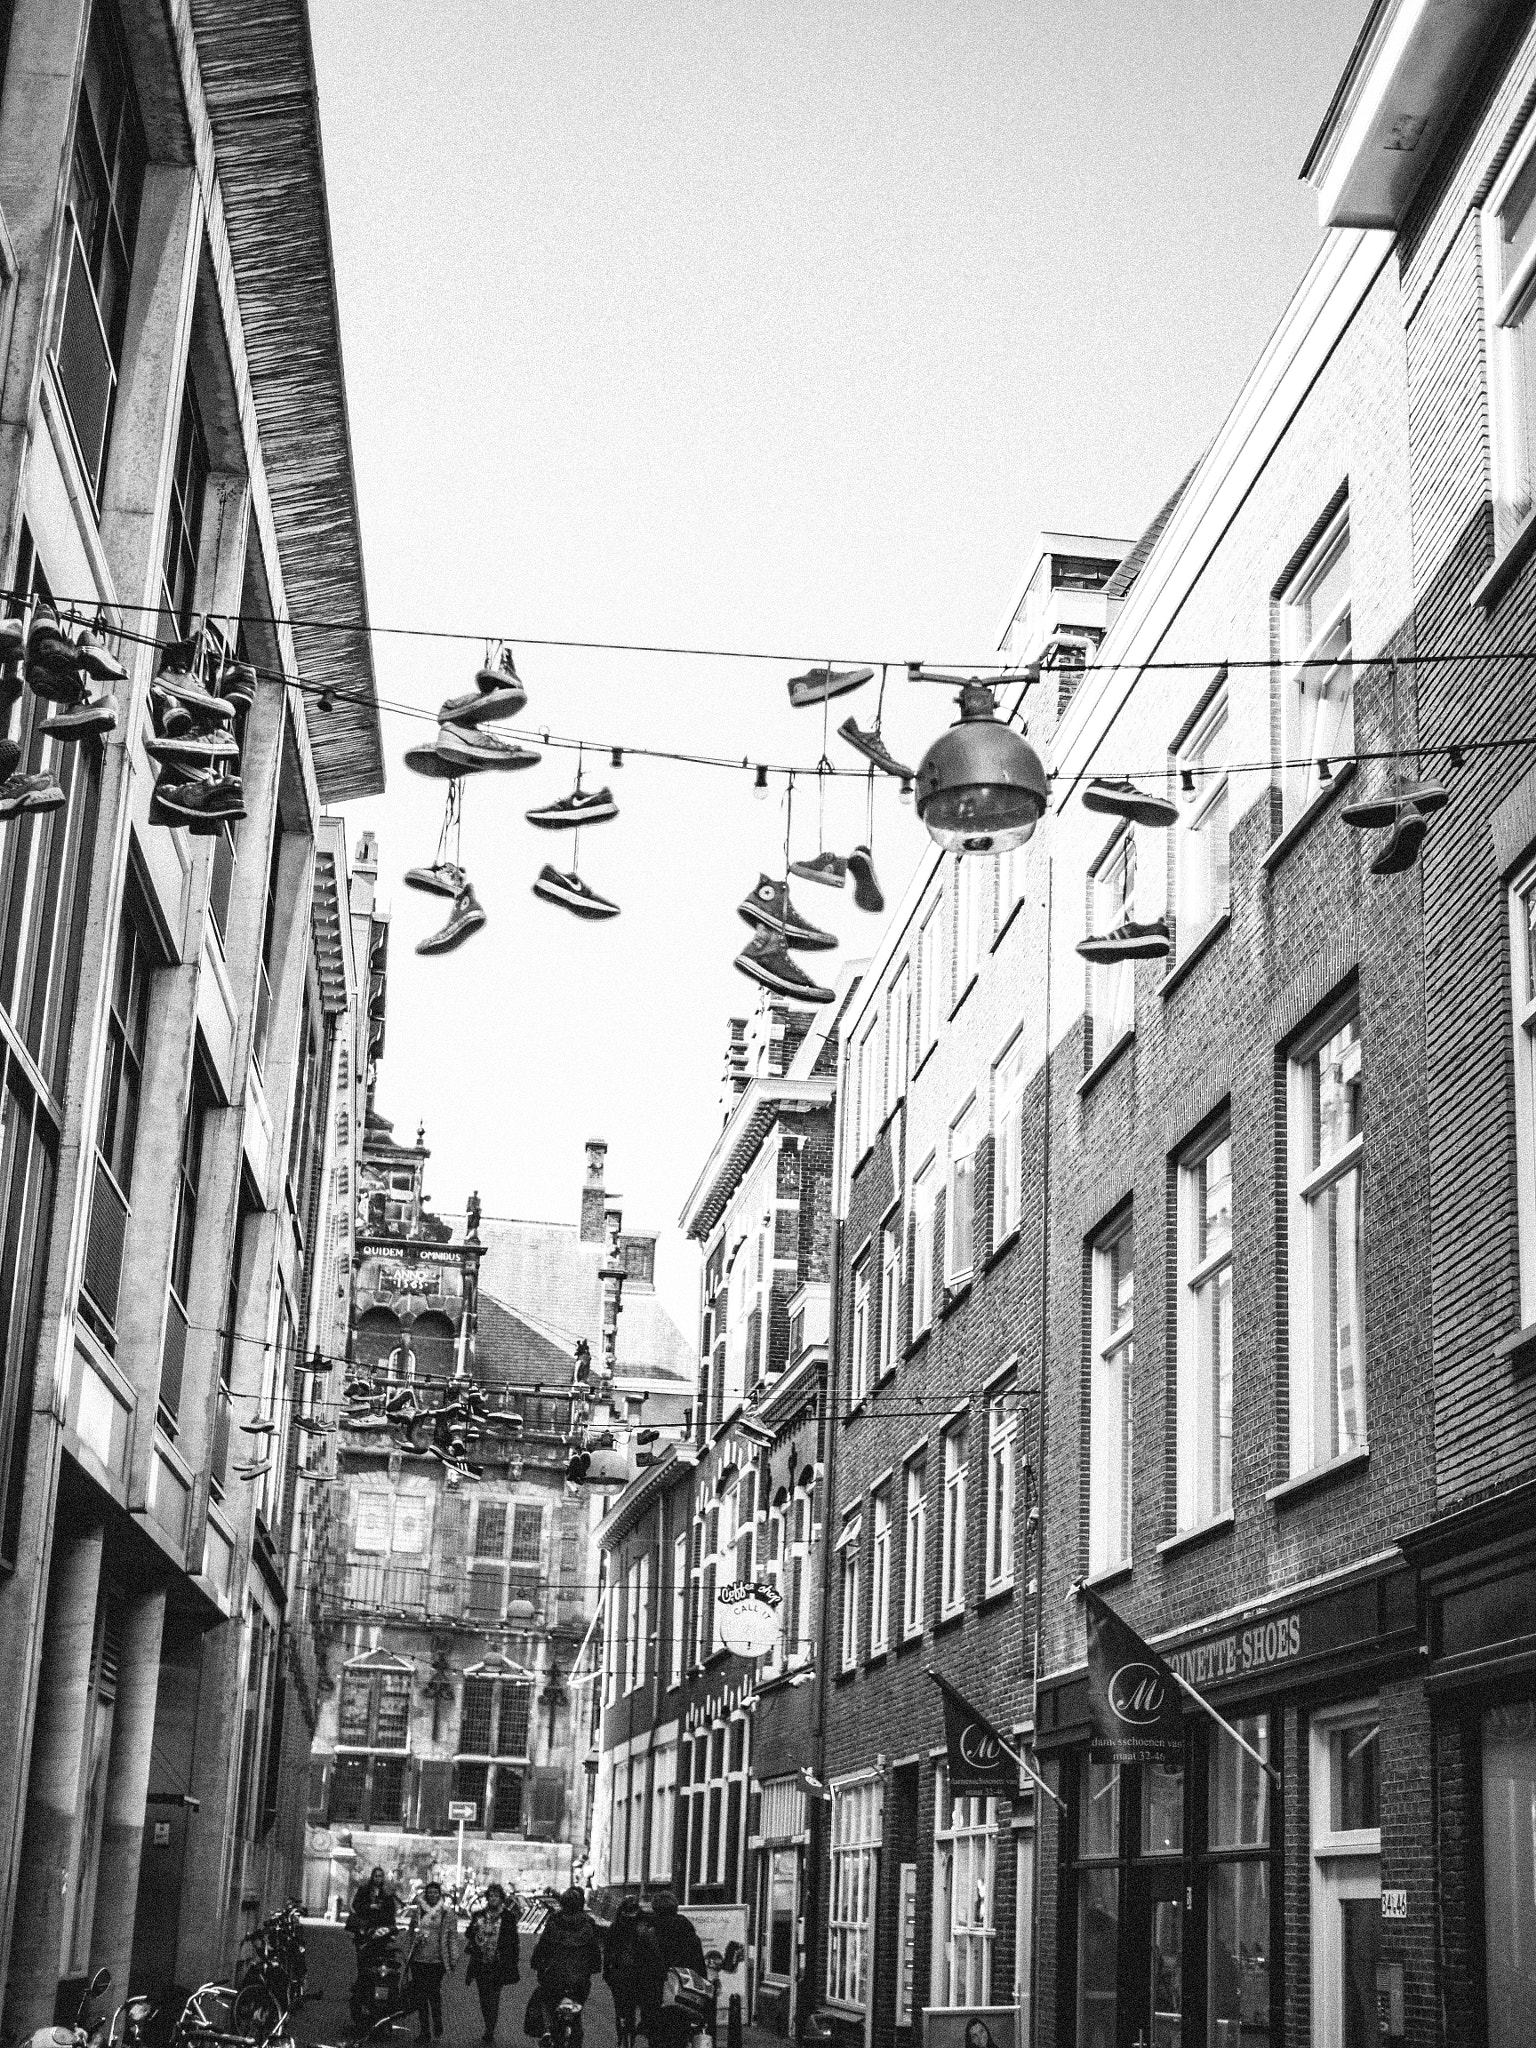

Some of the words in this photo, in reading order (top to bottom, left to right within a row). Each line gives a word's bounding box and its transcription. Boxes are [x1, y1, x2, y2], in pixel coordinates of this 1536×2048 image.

[363, 1246, 404, 1257] QUIDEM
[420, 1251, 461, 1261] OMNIBUS
[393, 1270, 427, 1280] ANNO
[733, 1604, 758, 1615] CALL
